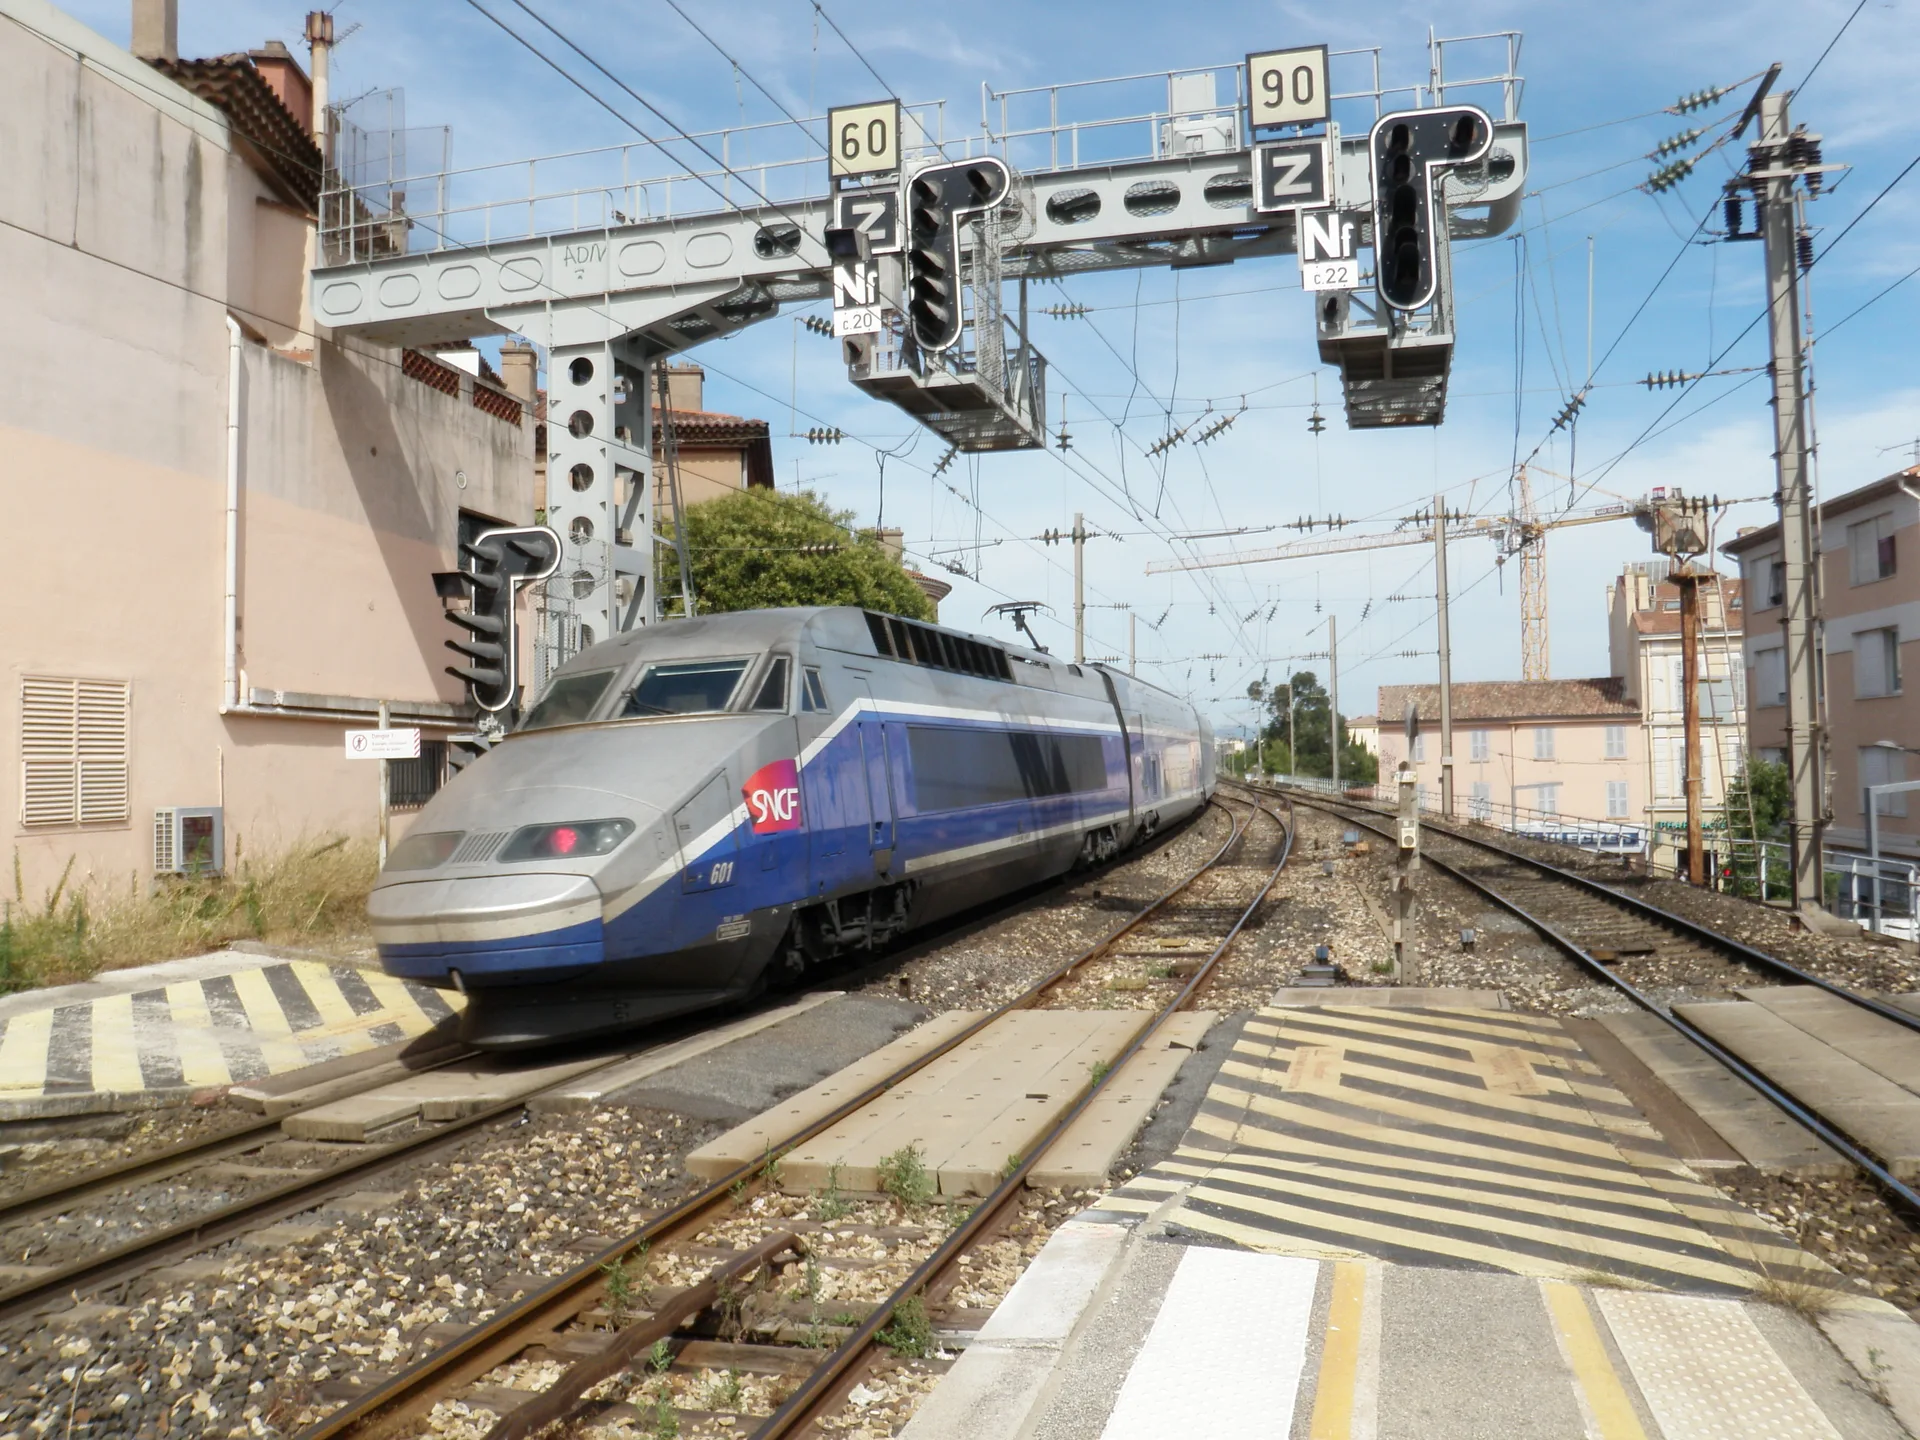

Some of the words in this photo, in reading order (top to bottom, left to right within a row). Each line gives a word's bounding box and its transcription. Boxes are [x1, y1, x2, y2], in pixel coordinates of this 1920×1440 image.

[1262, 65, 1314, 109] 90
[841, 119, 887, 160] 60
[1272, 154, 1312, 197] Z
[852, 202, 886, 240] Z
[1303, 213, 1354, 260] Nf
[834, 263, 878, 308] Nf
[751, 787, 799, 824] SNCF
[1659, 820, 1727, 830] PHARACE
[710, 861, 734, 885] 601
